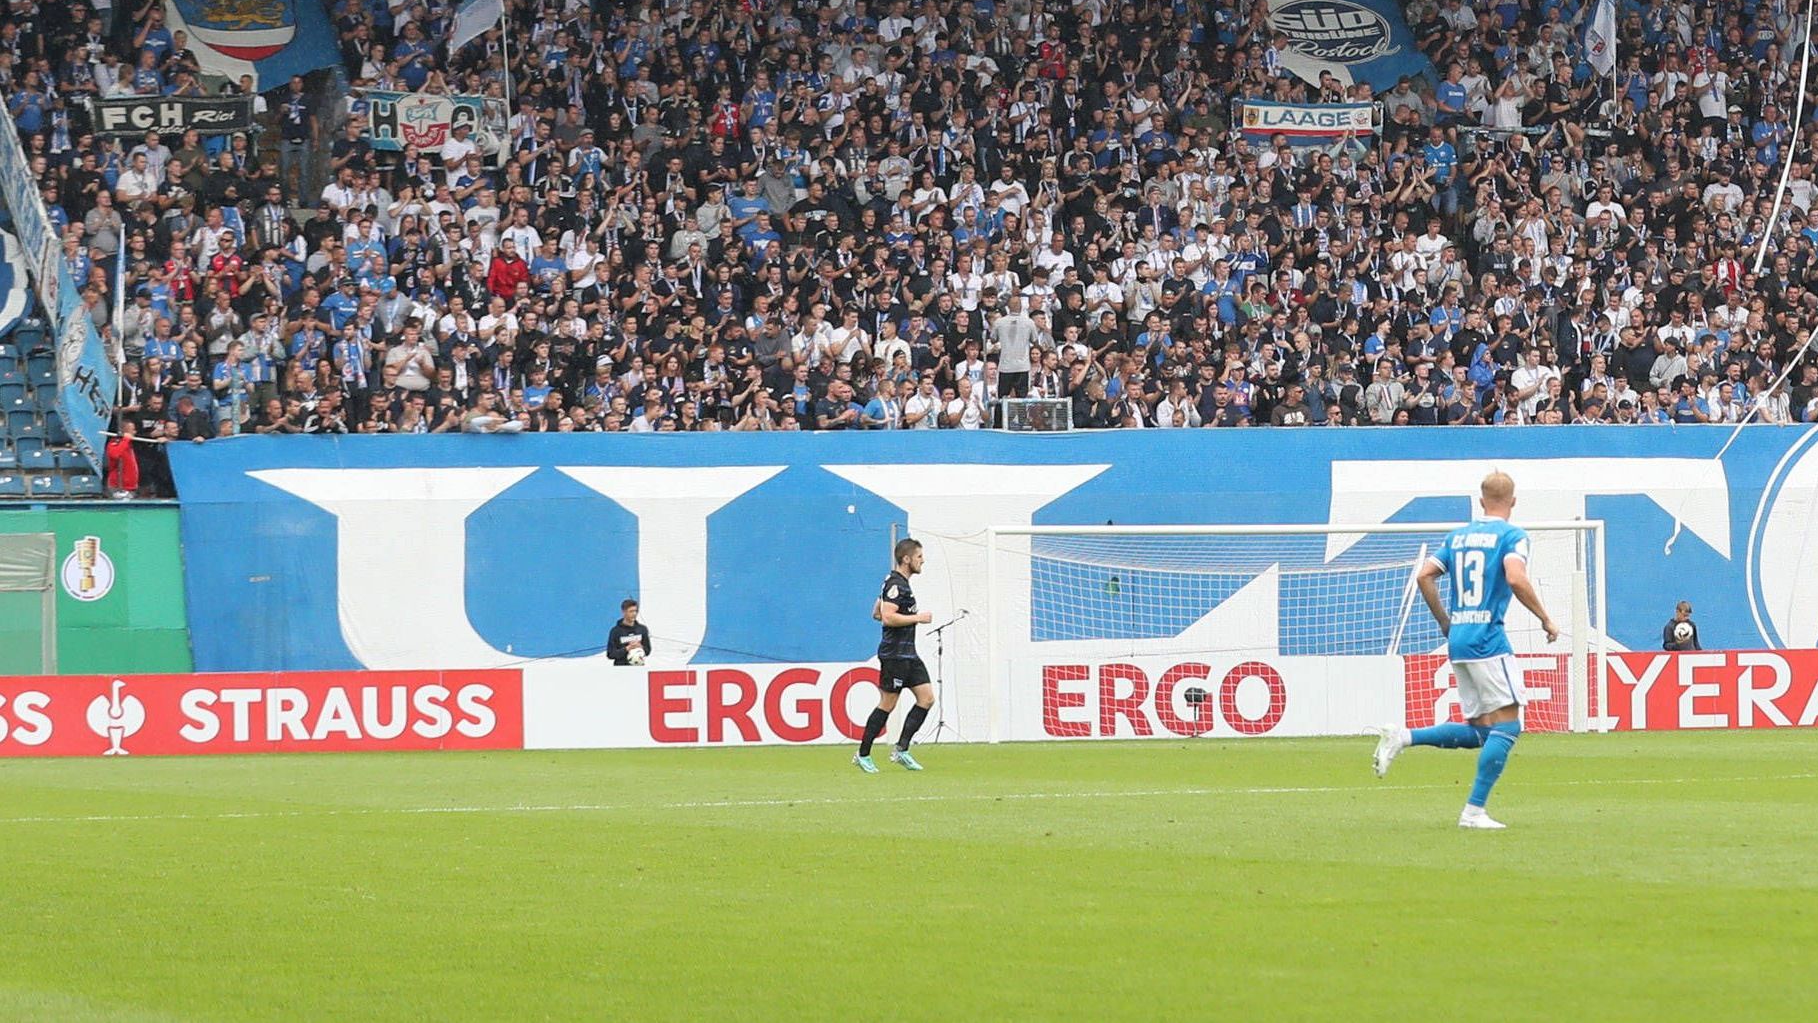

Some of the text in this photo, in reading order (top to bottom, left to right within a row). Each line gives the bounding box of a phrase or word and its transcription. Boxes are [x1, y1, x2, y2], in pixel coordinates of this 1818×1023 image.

[1273, 8, 1377, 31] SÜD
[1287, 36, 1401, 59] Rostock
[101, 102, 184, 130] FCH
[192, 109, 236, 124] Riot
[1263, 109, 1352, 127] LAAGE
[1455, 550, 1486, 609] 13
[178, 684, 497, 743] STRAUSS
[648, 668, 885, 743] ERGO
[1042, 662, 1288, 738] ERGO
